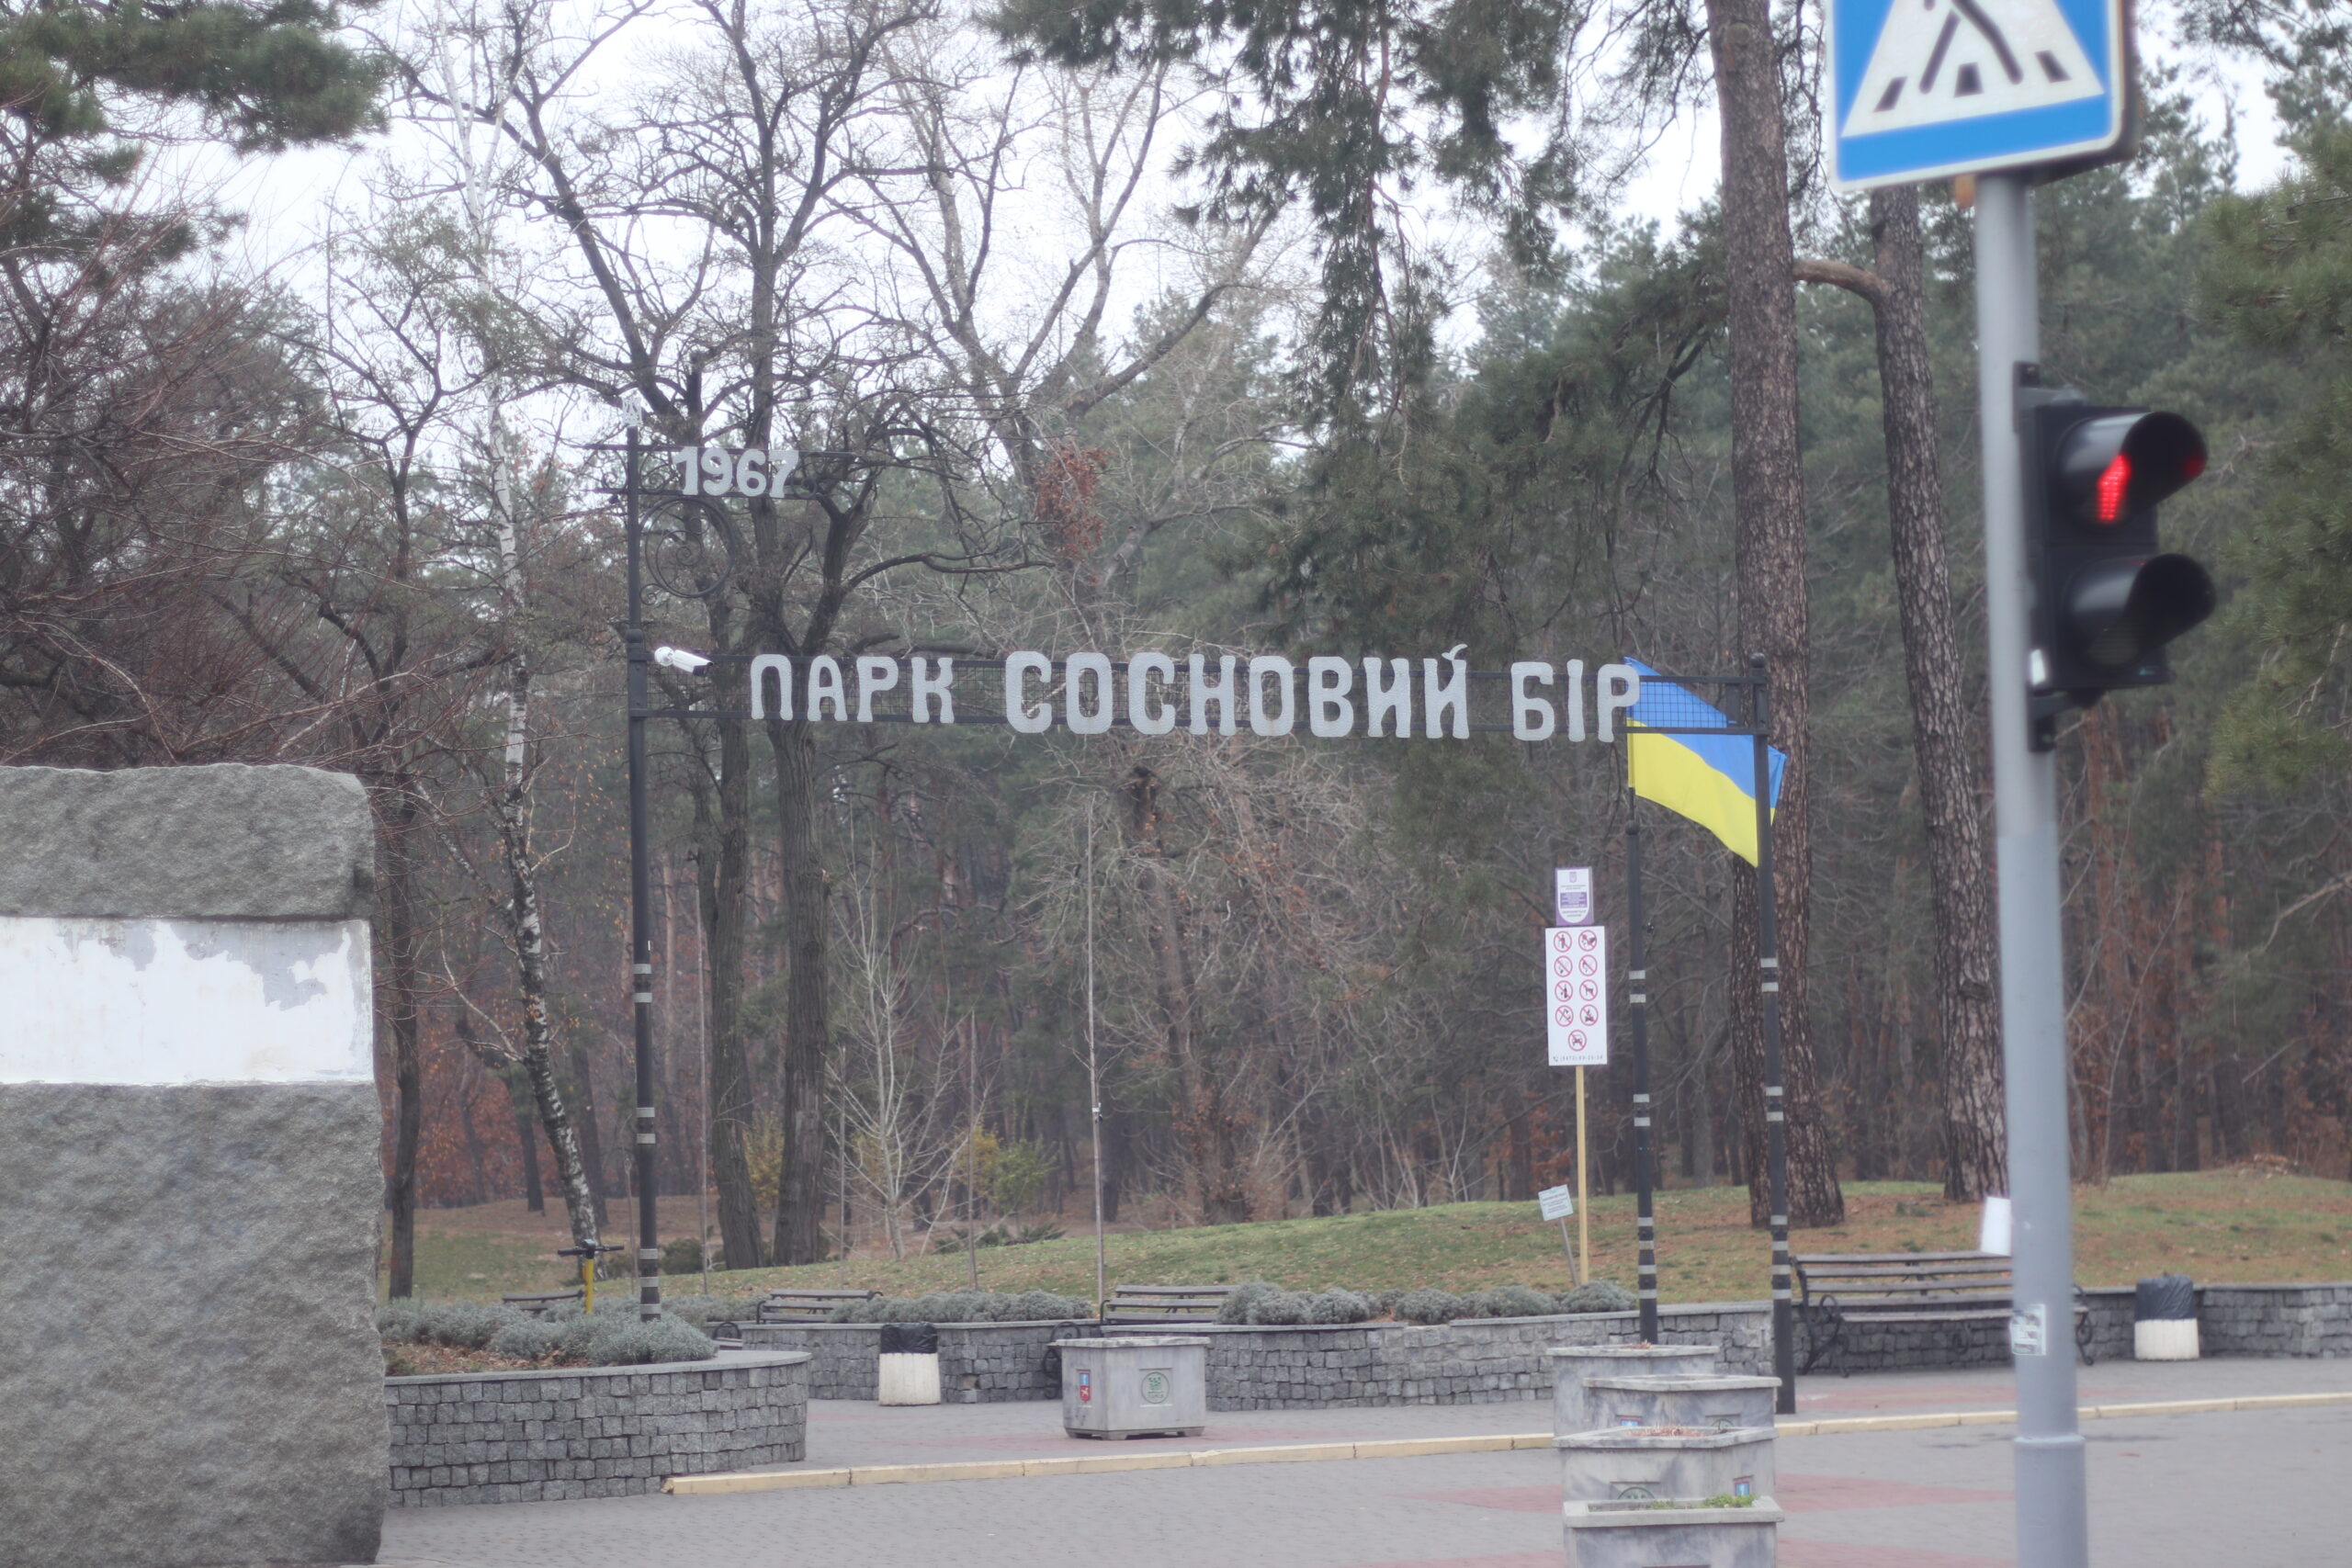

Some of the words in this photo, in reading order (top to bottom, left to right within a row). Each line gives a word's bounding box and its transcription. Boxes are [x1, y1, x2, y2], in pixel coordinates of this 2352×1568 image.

[672, 446, 799, 499] 1967
[750, 653, 954, 724] ПАРК
[1005, 643, 1470, 739] СОСНОВИЙ
[1511, 659, 1641, 742] БІР
